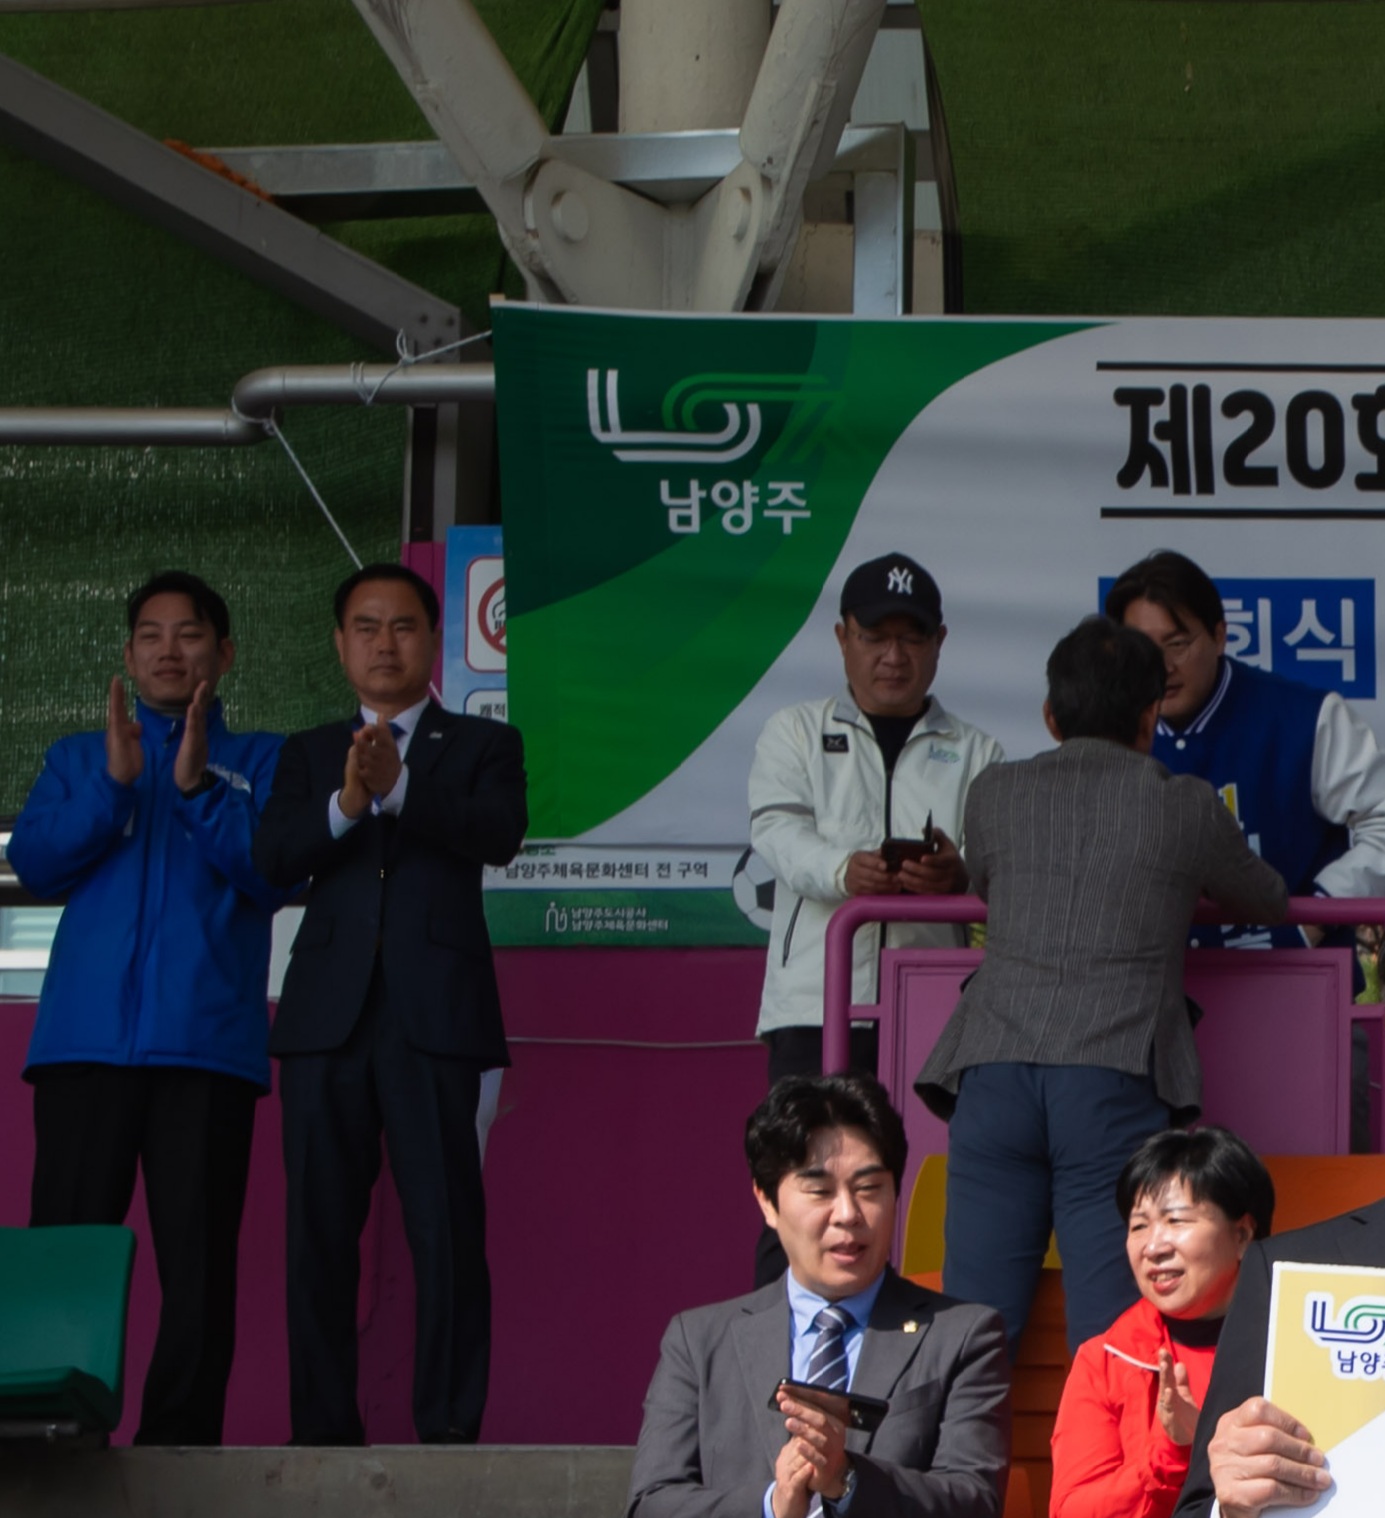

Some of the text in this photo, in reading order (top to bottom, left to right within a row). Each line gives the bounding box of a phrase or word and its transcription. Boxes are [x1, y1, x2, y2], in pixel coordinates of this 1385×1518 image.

[661, 479, 811, 533] 남양주
[1222, 598, 1356, 682] 회식
[505, 862, 708, 879] 남양주체육문화센터 전 구역
